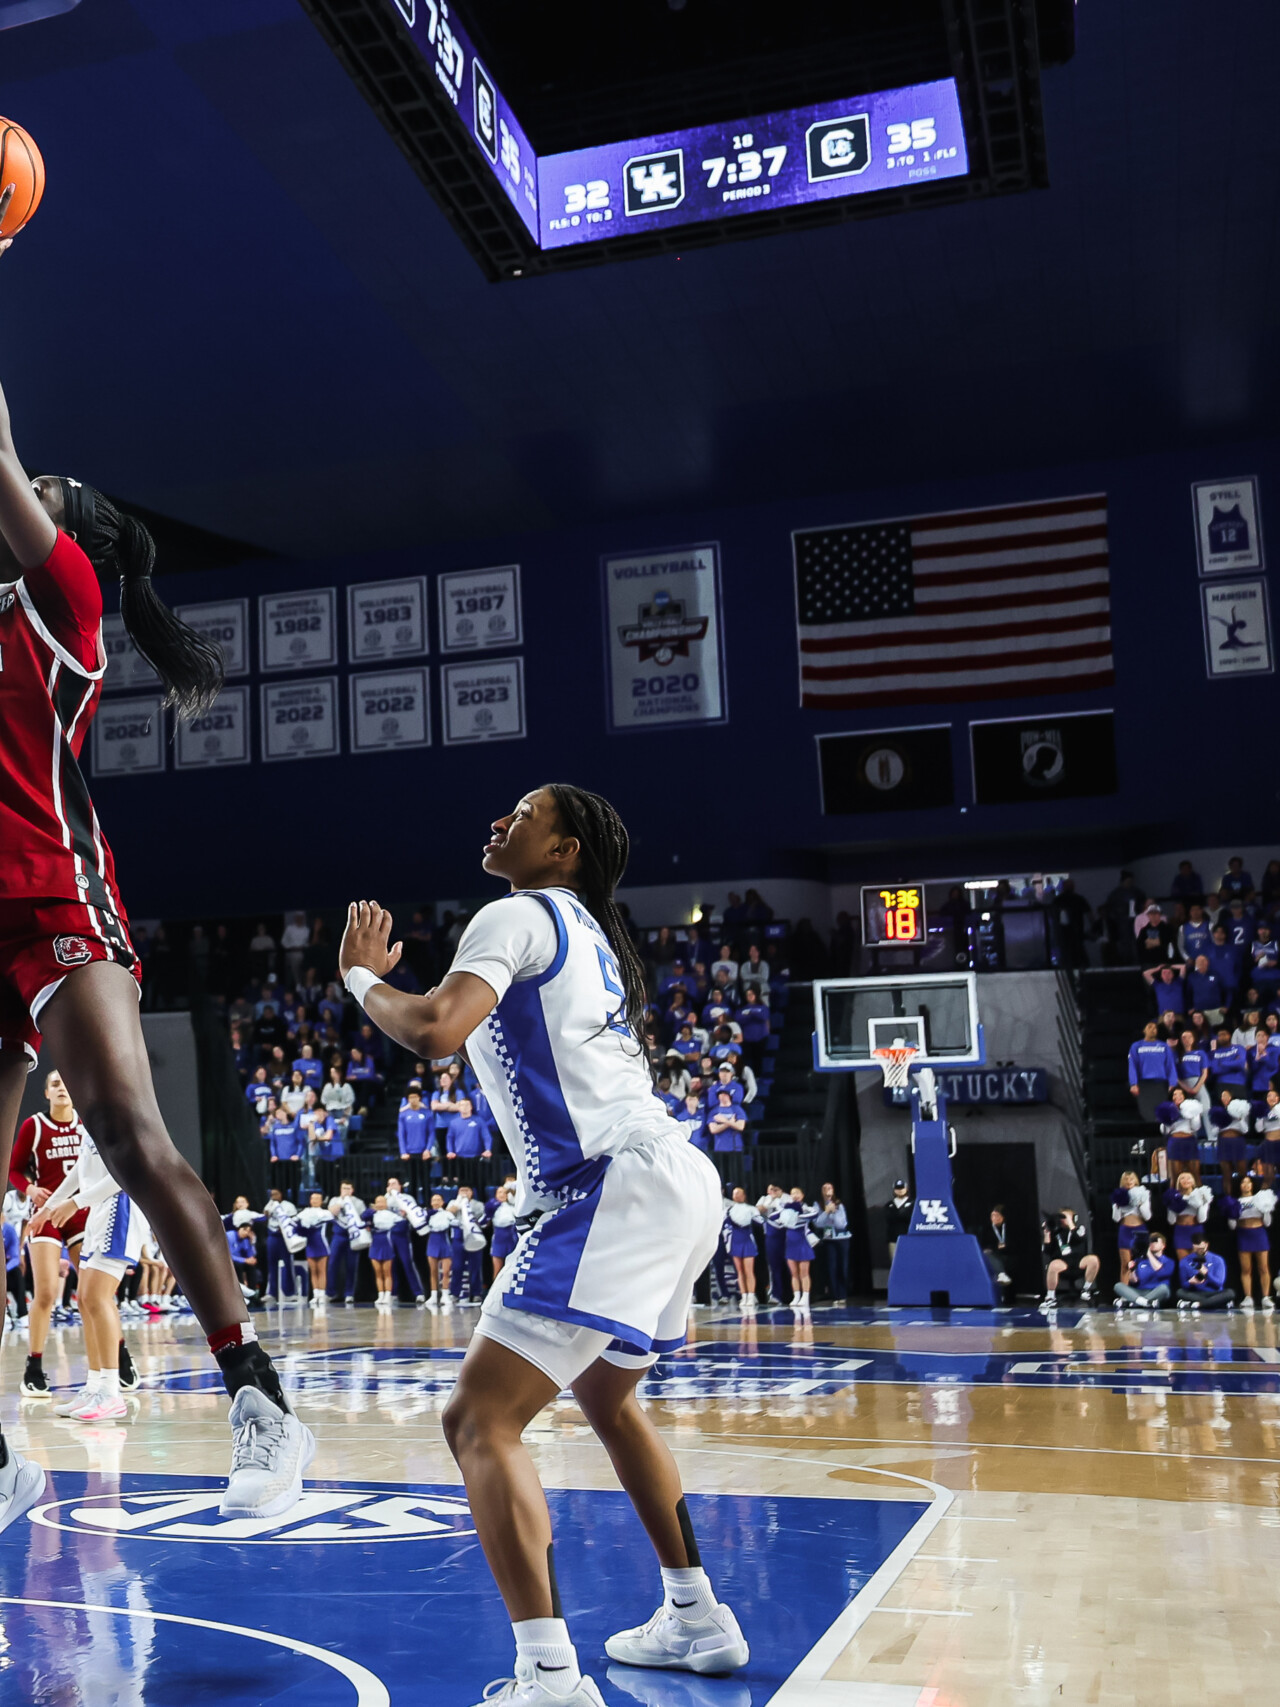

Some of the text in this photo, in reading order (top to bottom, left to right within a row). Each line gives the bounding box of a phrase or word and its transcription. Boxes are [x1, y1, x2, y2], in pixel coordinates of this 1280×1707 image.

[886, 117, 937, 155] 35
[701, 145, 788, 189] 7:37
[564, 180, 610, 215] 32
[722, 187, 760, 203] PERIOD
[613, 558, 707, 580] VOLLEYBALL
[455, 594, 505, 615] 1987
[274, 616, 322, 636] 1982
[363, 605, 412, 626] 1983
[632, 672, 700, 698] 2020
[364, 695, 415, 716] 2022
[457, 686, 509, 707] 2023
[275, 704, 325, 725] 2022
[104, 722, 152, 741] 2020
[879, 889, 920, 909] 7:36
[885, 908, 917, 941] 18
[1232, 926, 1246, 945] 2
[51, 1134, 81, 1148] SOUTH
[919, 1199, 949, 1223] UK
